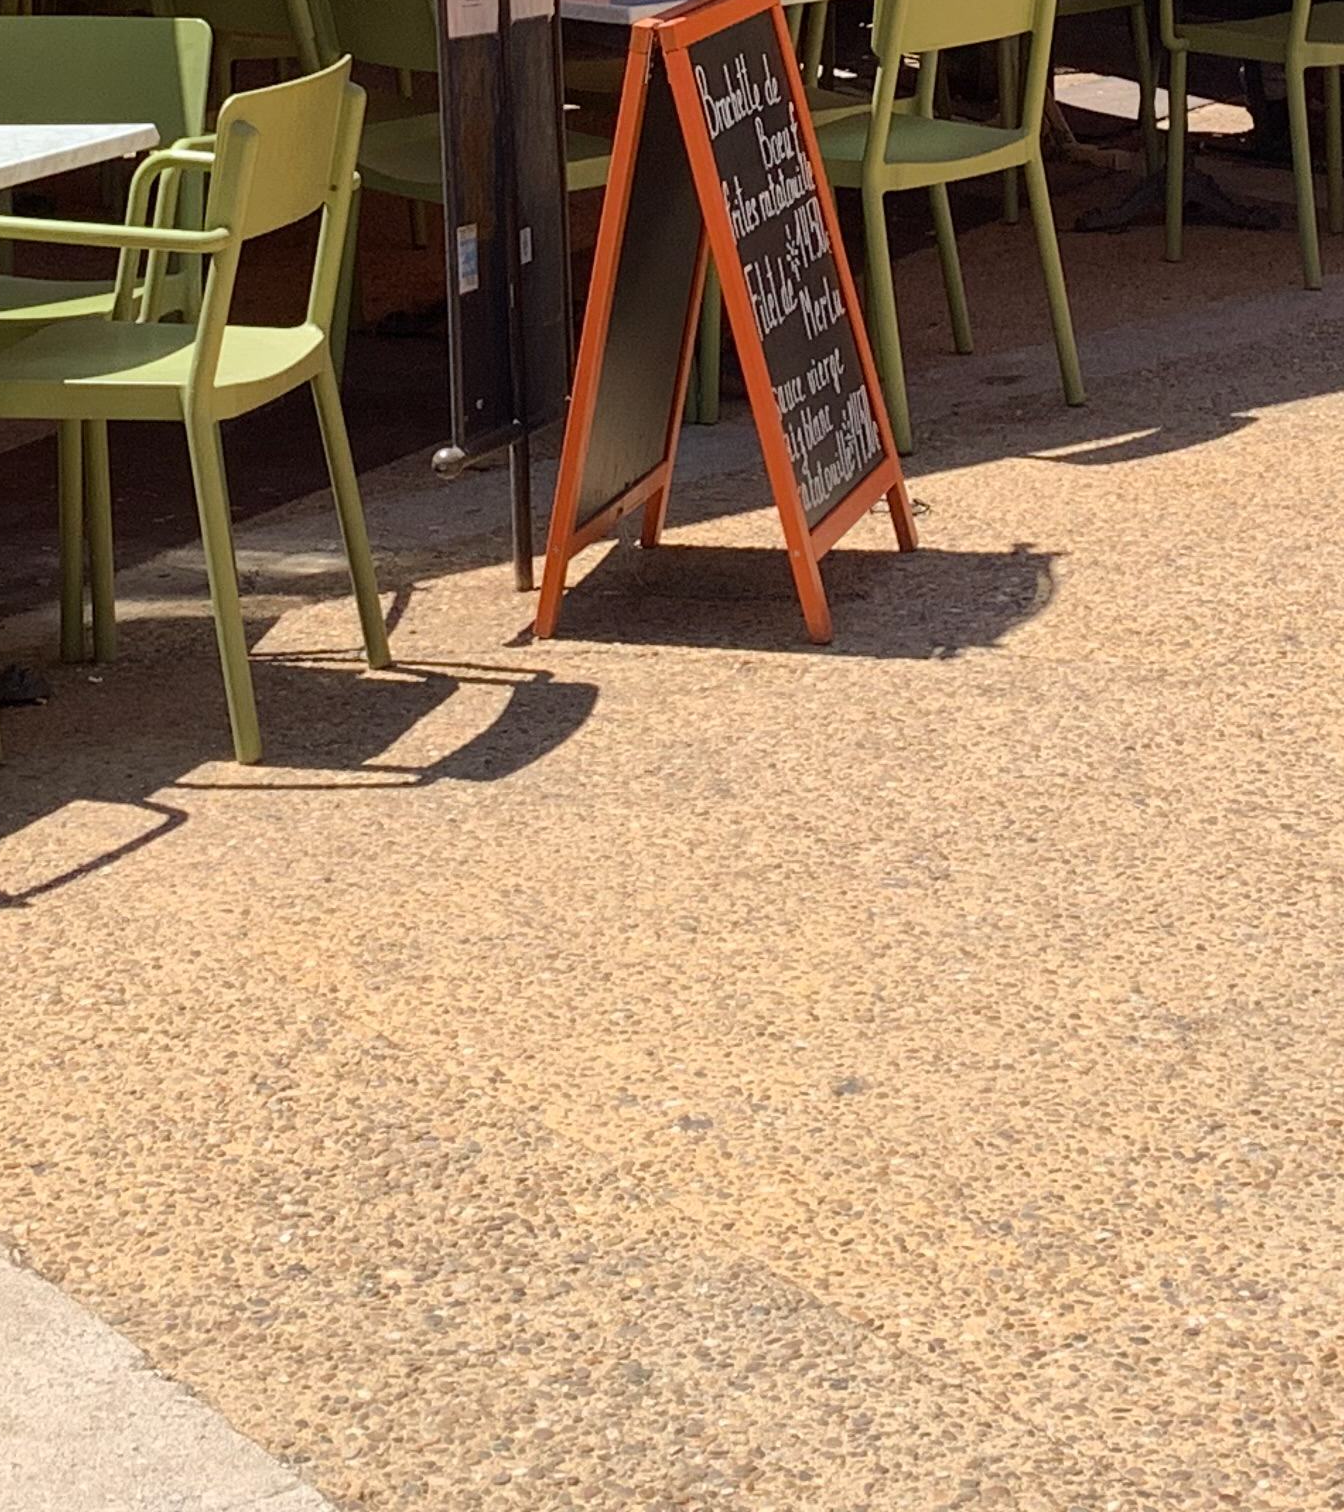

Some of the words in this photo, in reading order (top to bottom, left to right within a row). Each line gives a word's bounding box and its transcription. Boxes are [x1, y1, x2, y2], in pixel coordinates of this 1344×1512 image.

[762, 53, 782, 107] de
[777, 257, 798, 316] de
[799, 276, 846, 341] Merlu
[806, 348, 844, 394] vierge
